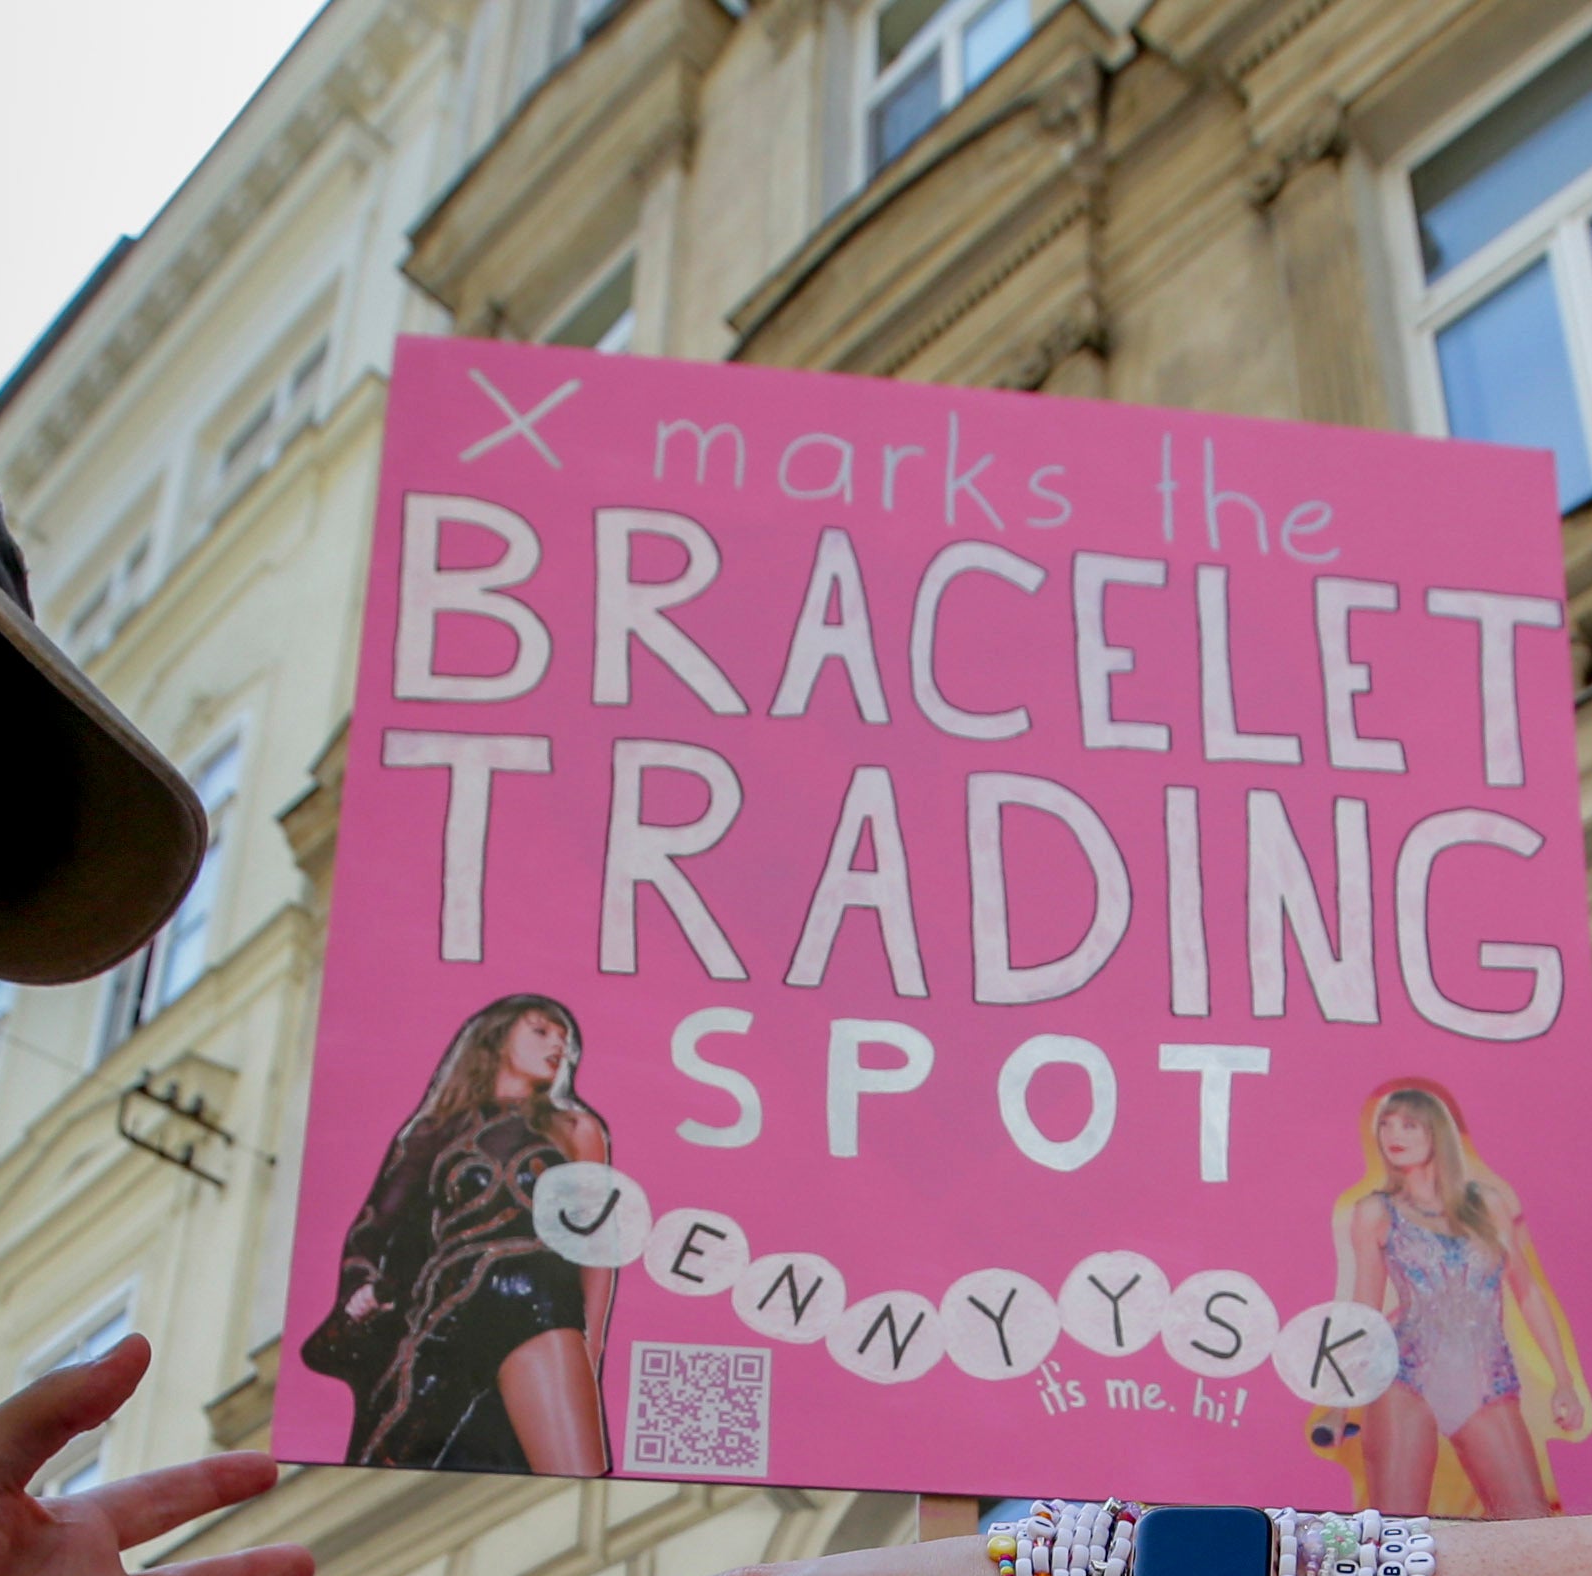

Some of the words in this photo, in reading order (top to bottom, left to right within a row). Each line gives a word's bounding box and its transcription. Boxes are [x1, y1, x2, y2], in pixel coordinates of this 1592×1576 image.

[459, 369, 580, 468] X
[653, 413, 1074, 529] marks
[1158, 432, 1340, 563] the
[392, 490, 1564, 788] BRACELET
[381, 728, 1565, 1040] TRADING
[669, 1009, 1270, 1184] SPOT
[1193, 1377, 1248, 1428] hi!
